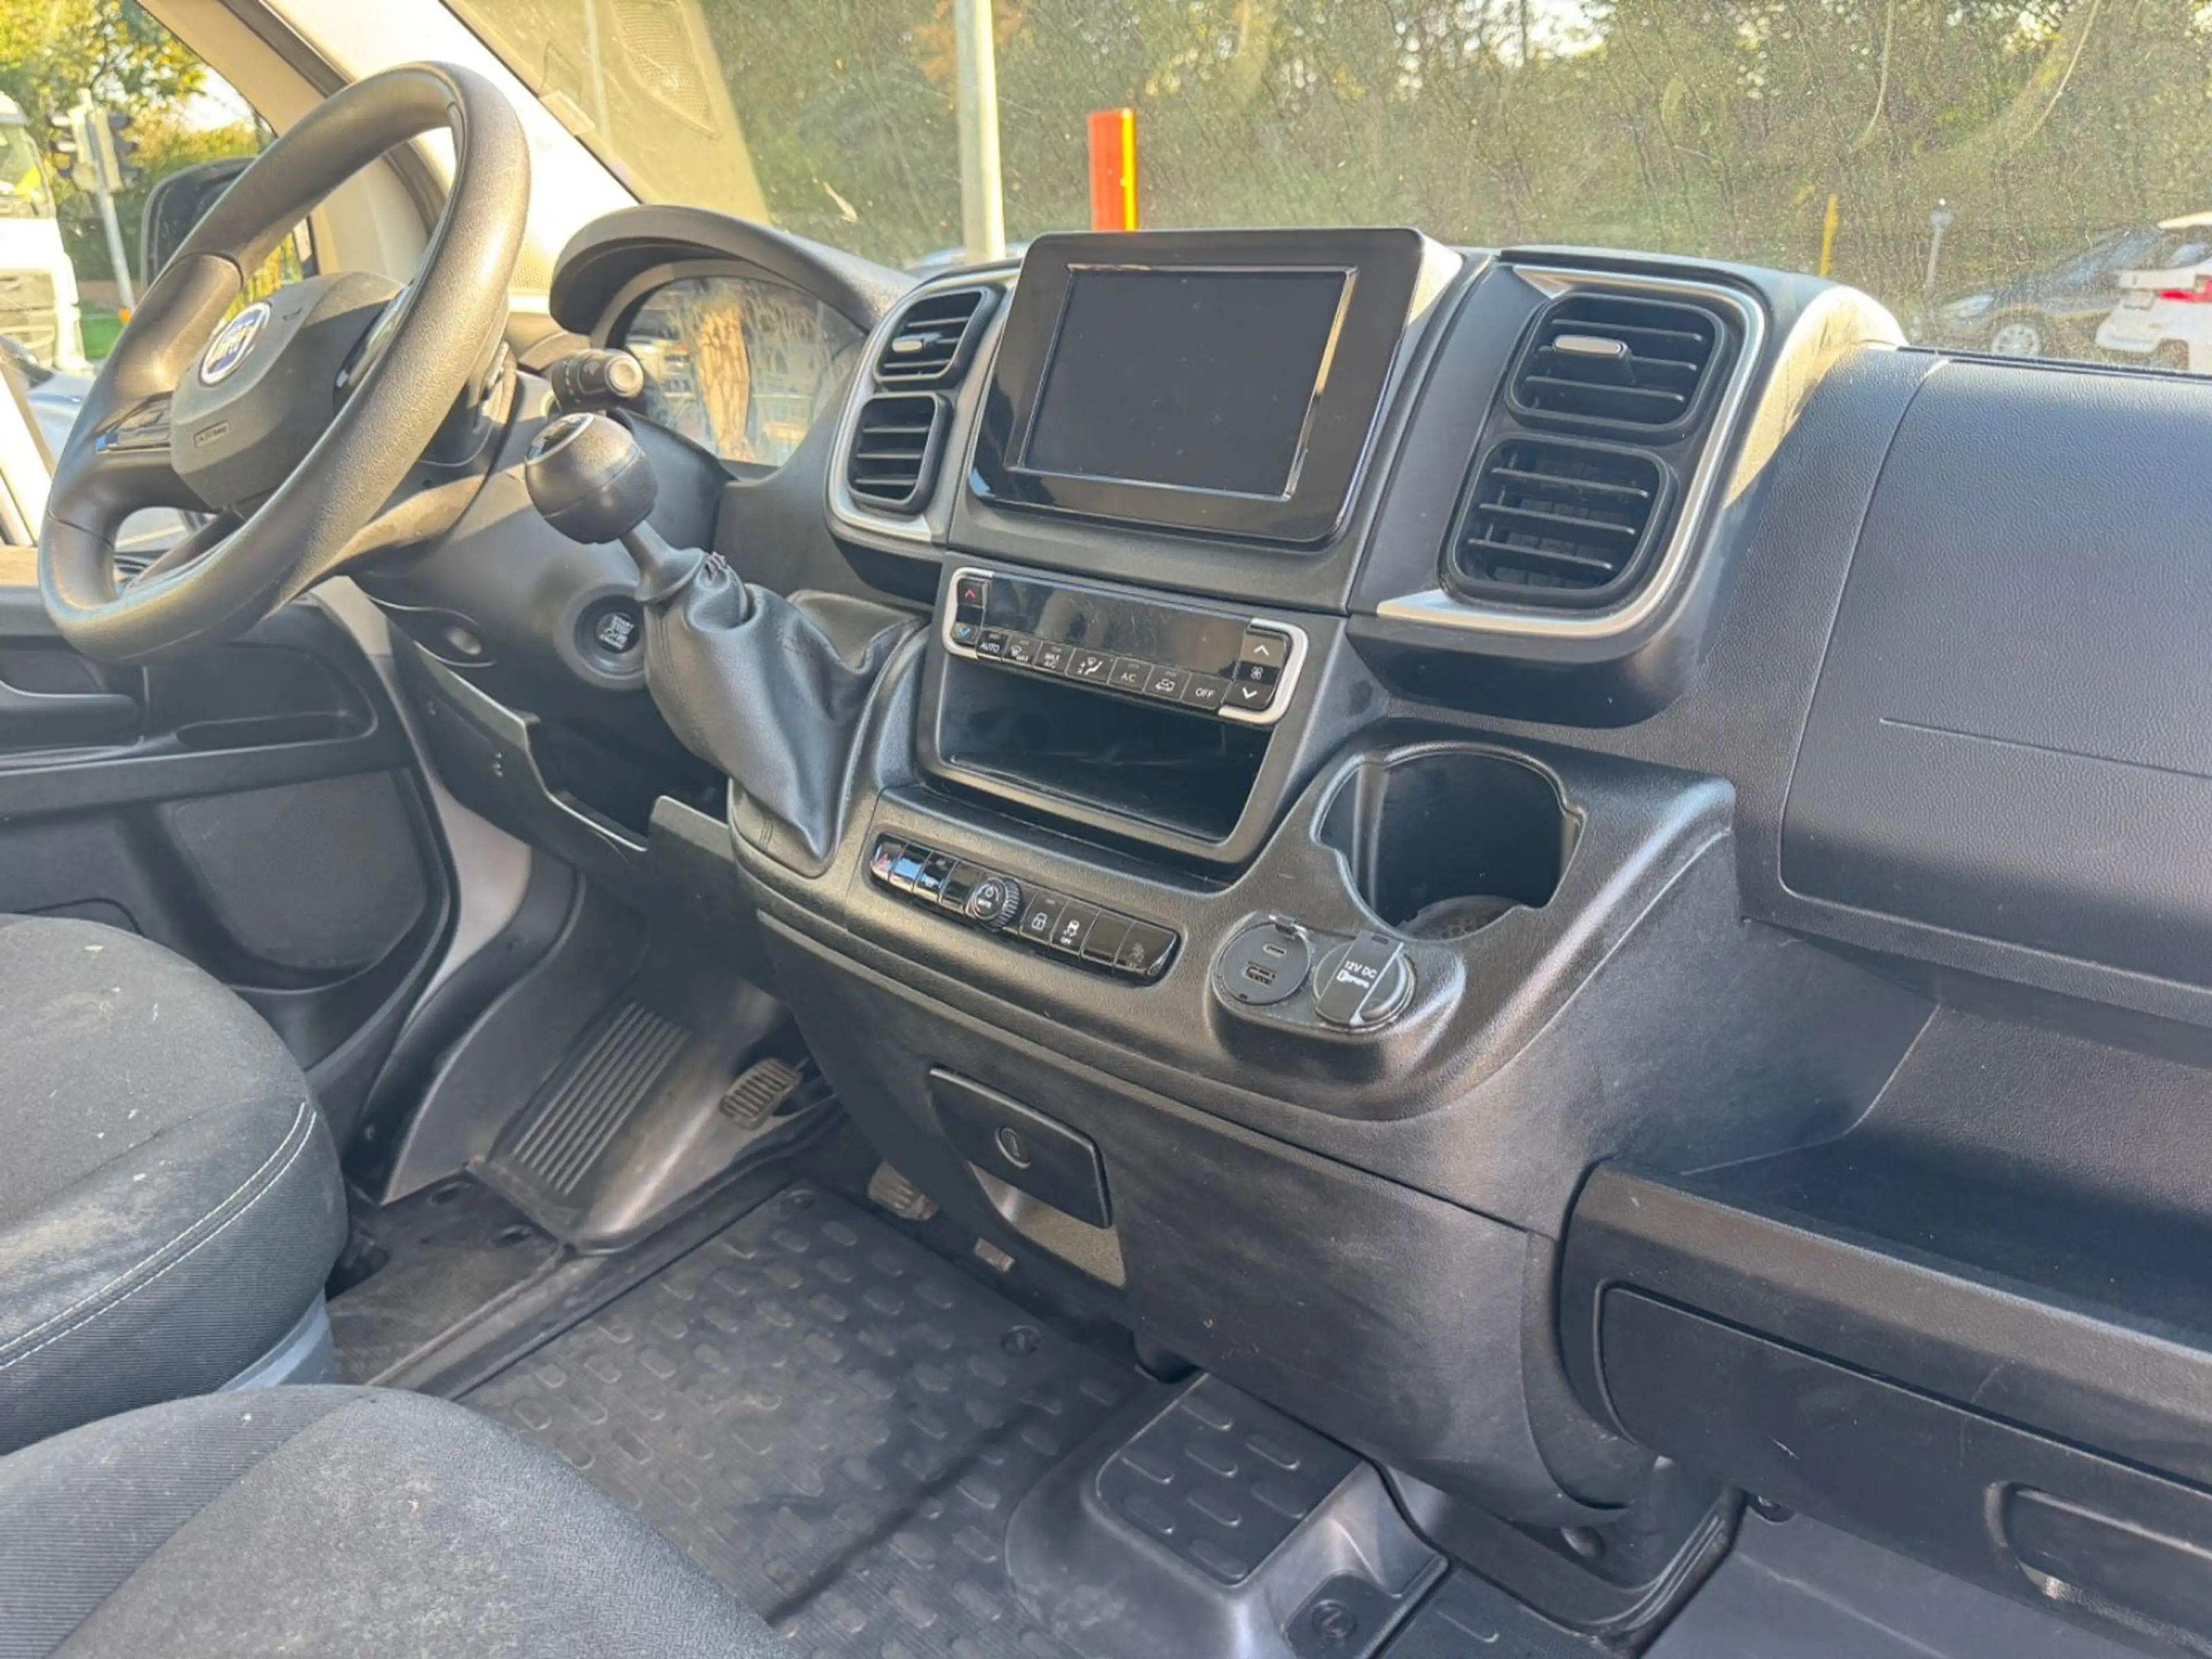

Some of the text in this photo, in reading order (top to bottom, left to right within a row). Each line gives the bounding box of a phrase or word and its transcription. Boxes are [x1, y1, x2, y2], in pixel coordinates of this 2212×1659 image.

[980, 642, 1000, 653] AUTO
[1195, 687, 1216, 698] OFF
[1344, 960, 1377, 979] 12V DC
